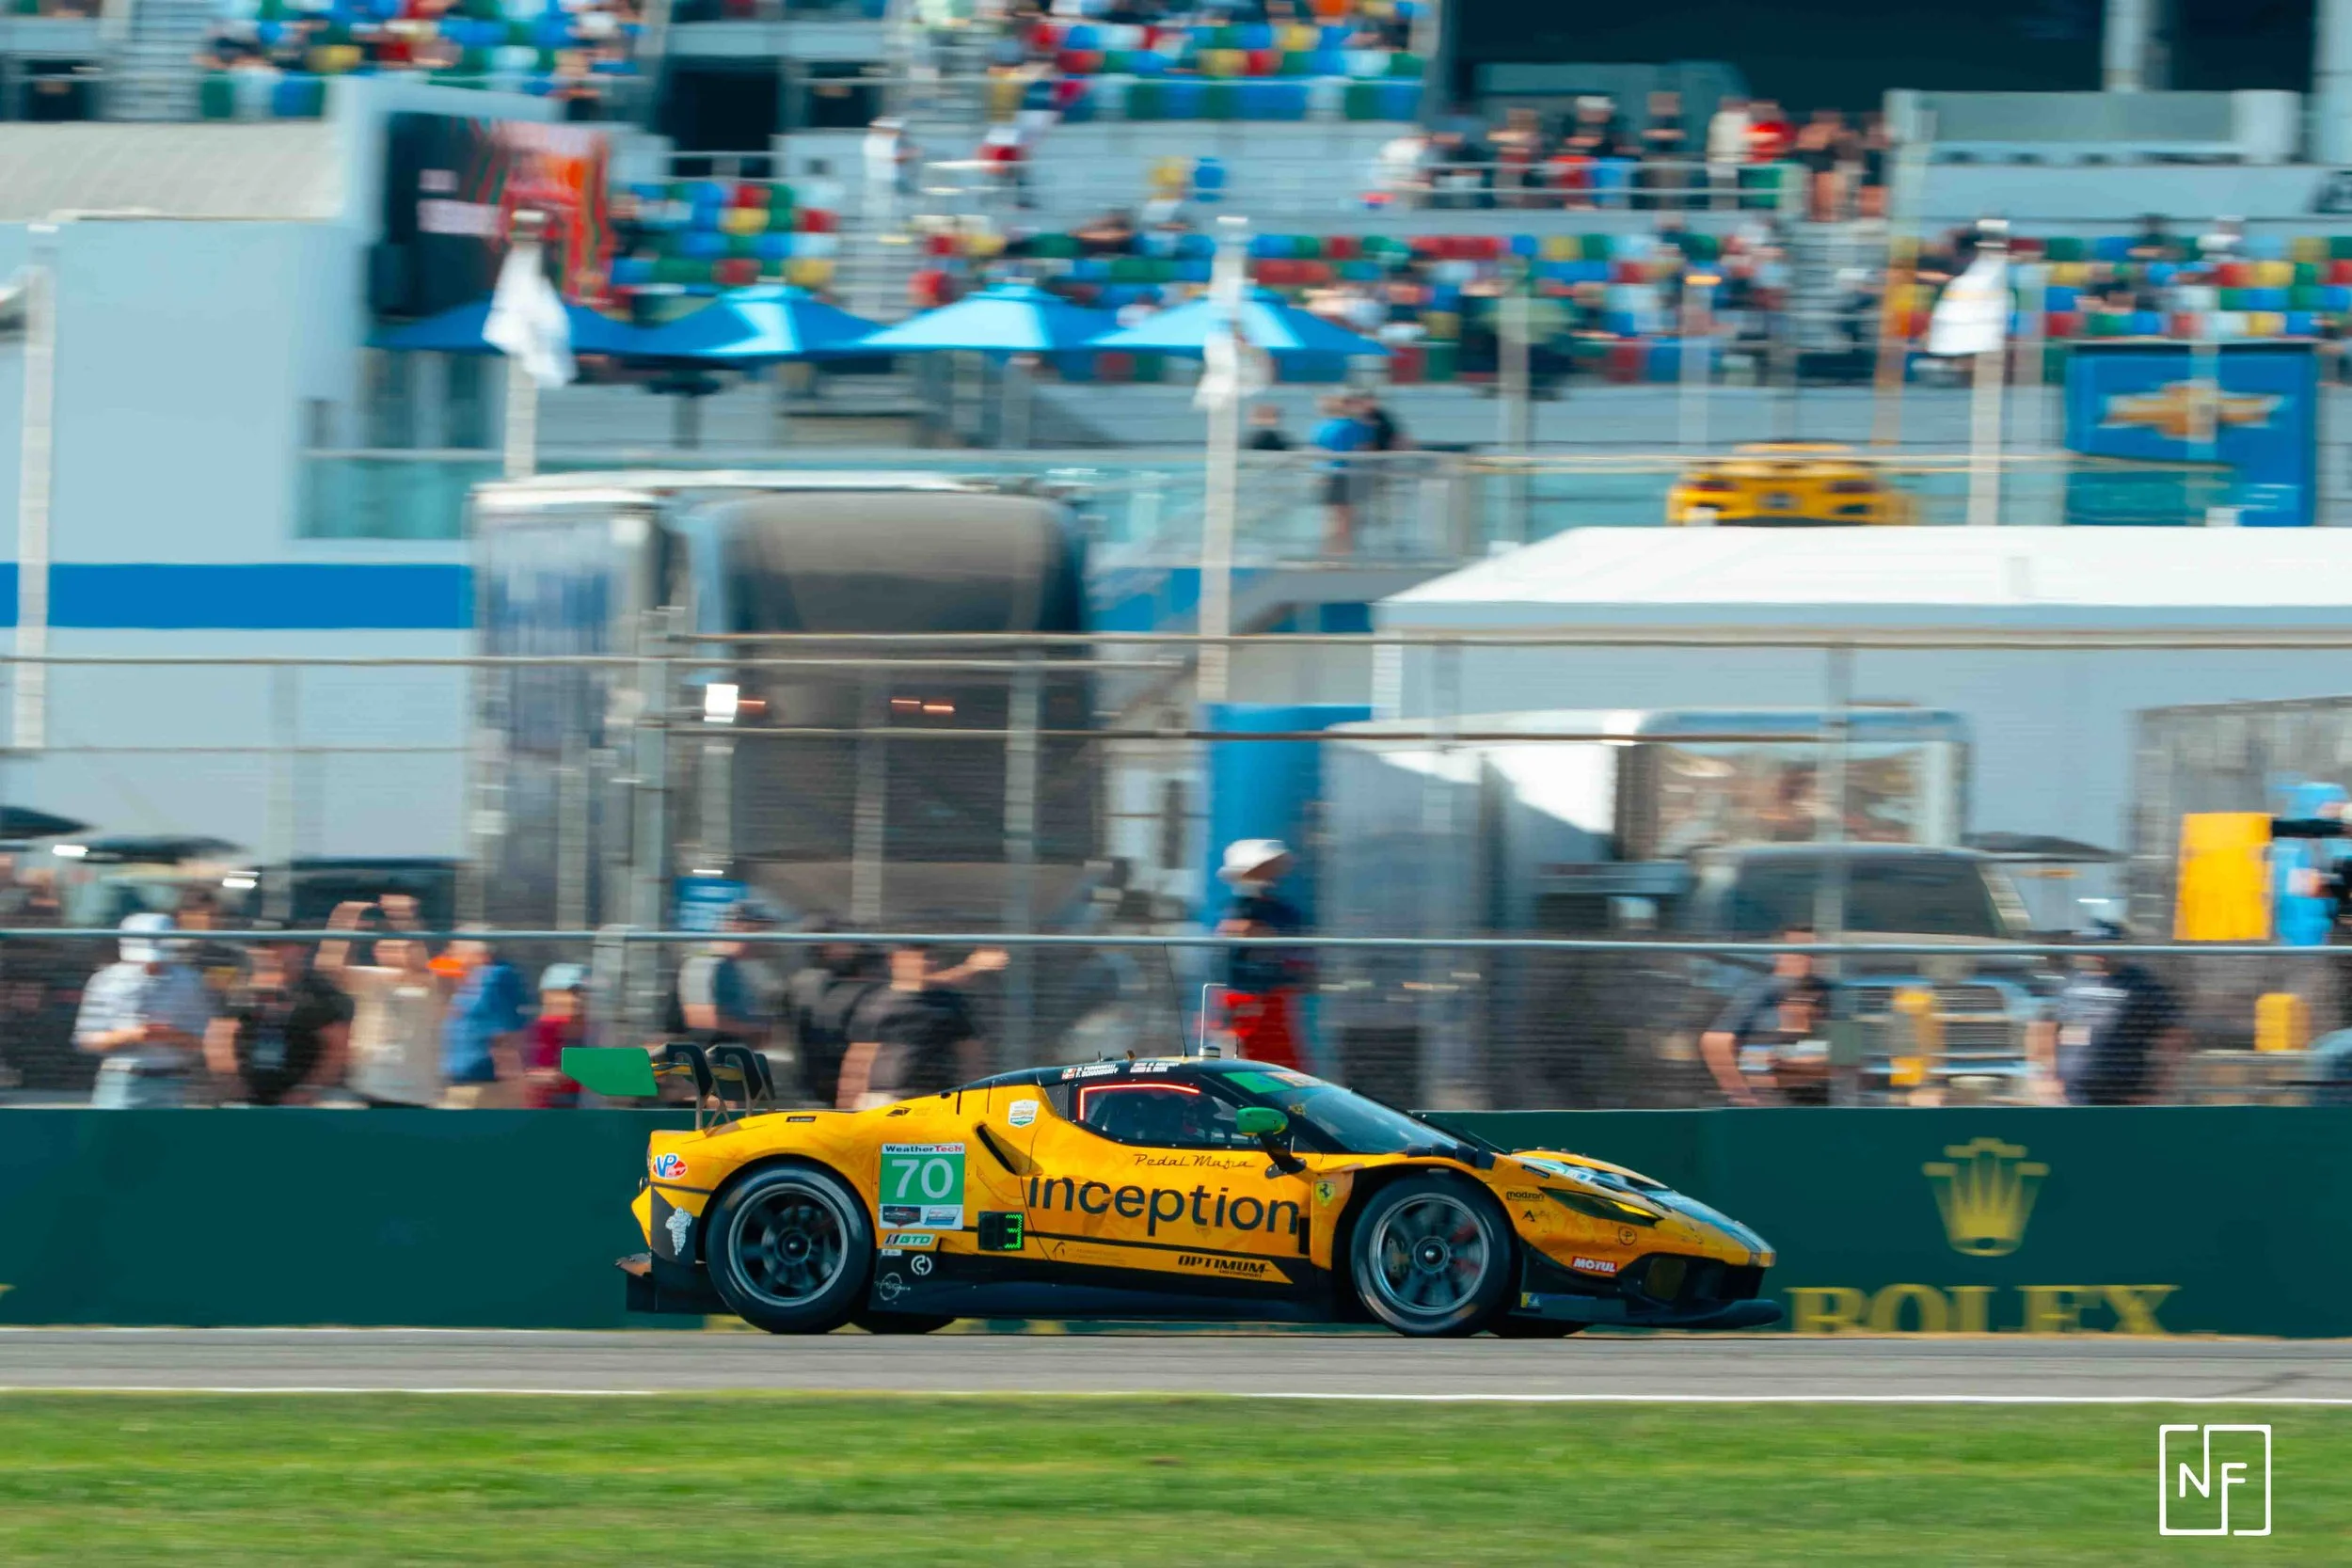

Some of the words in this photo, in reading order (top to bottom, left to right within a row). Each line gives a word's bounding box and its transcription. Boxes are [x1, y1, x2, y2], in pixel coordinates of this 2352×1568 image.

[657, 1154, 677, 1178] VP
[1133, 1153, 1189, 1166] Pedal
[891, 1158, 954, 1199] 70
[1028, 1176, 1300, 1237] inception
[1004, 1213, 1023, 1249] 3
[1178, 1255, 1265, 1274] OPTIMUM
[1573, 1258, 1615, 1273] MOTUL
[1784, 1283, 2181, 1334] ROLEX
